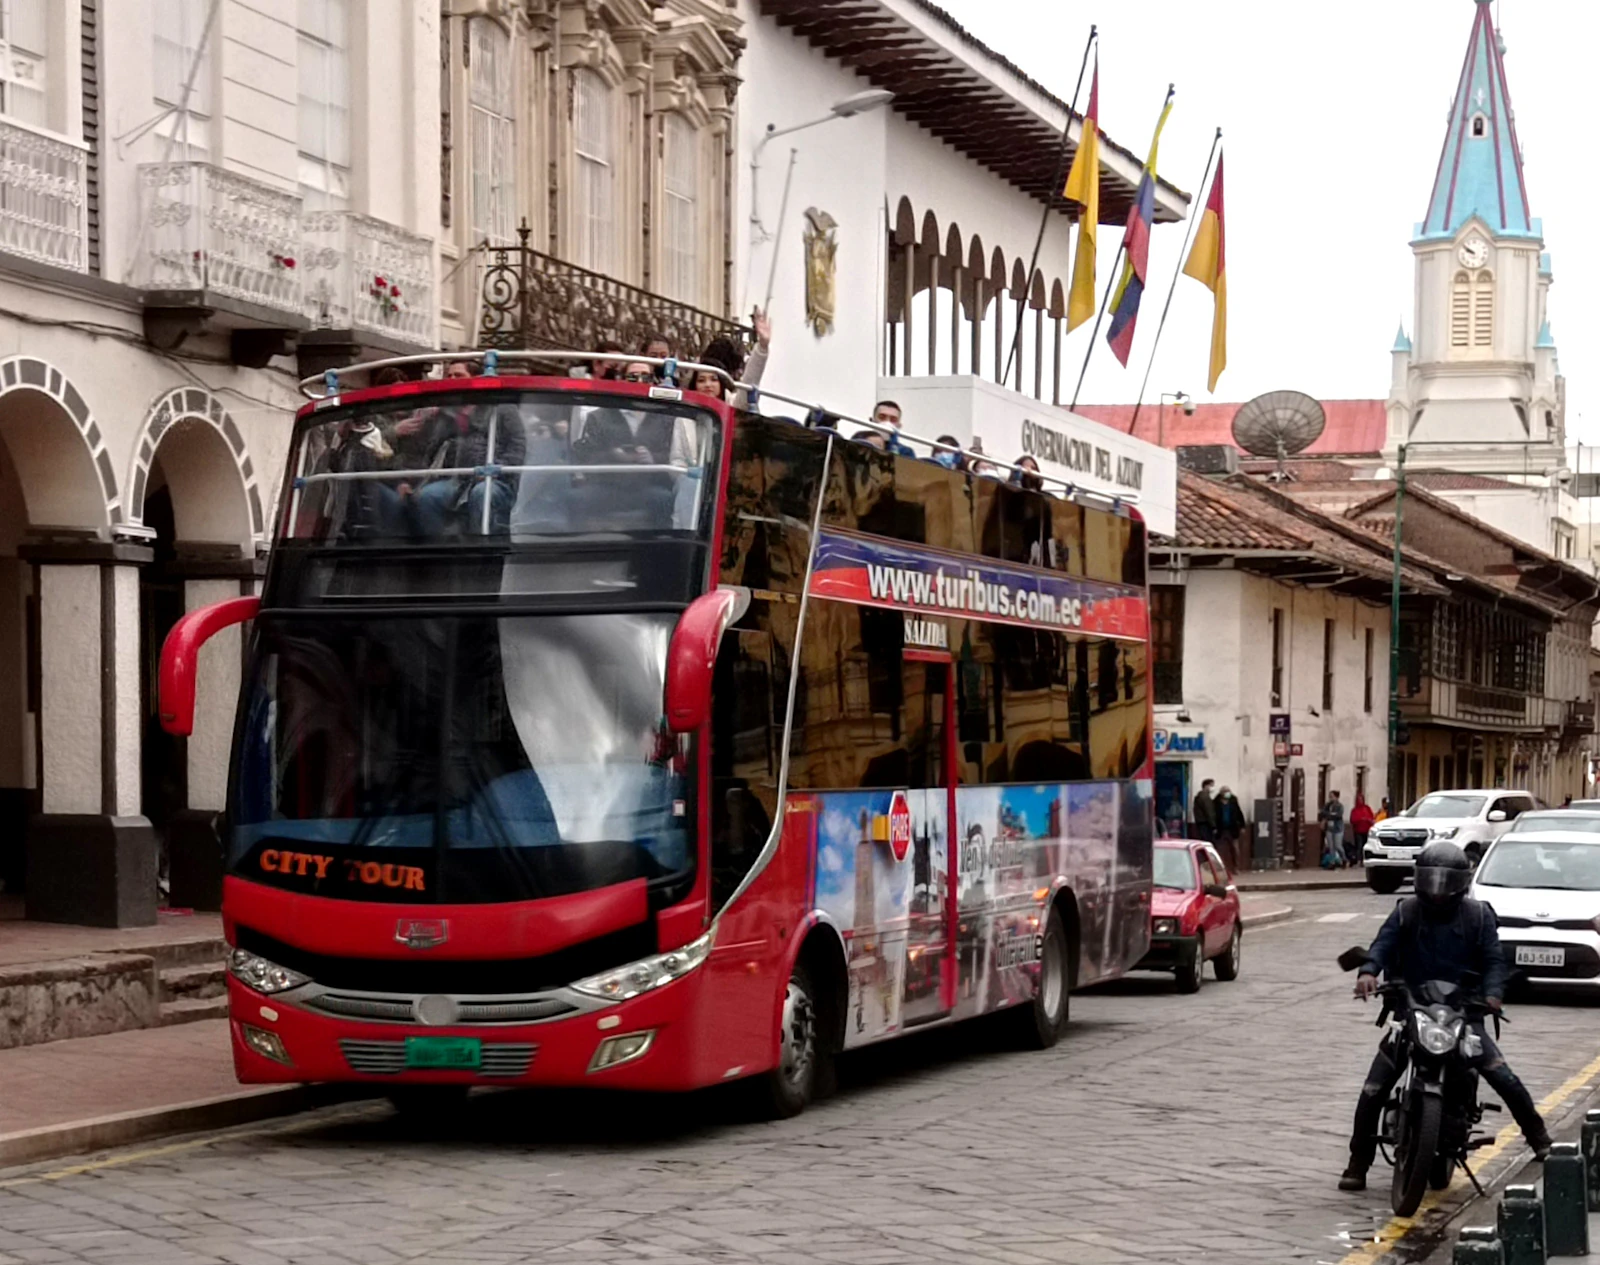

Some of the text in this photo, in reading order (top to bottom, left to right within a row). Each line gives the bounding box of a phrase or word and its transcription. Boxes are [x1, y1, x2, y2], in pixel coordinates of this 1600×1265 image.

[1095, 446, 1112, 481] DEL
[867, 563, 1082, 626] www.turibus.com.ec
[904, 617, 948, 648] SALIDA
[1168, 731, 1204, 751] Azul
[891, 813, 909, 842] PARE
[260, 849, 425, 890] CITY TOUR
